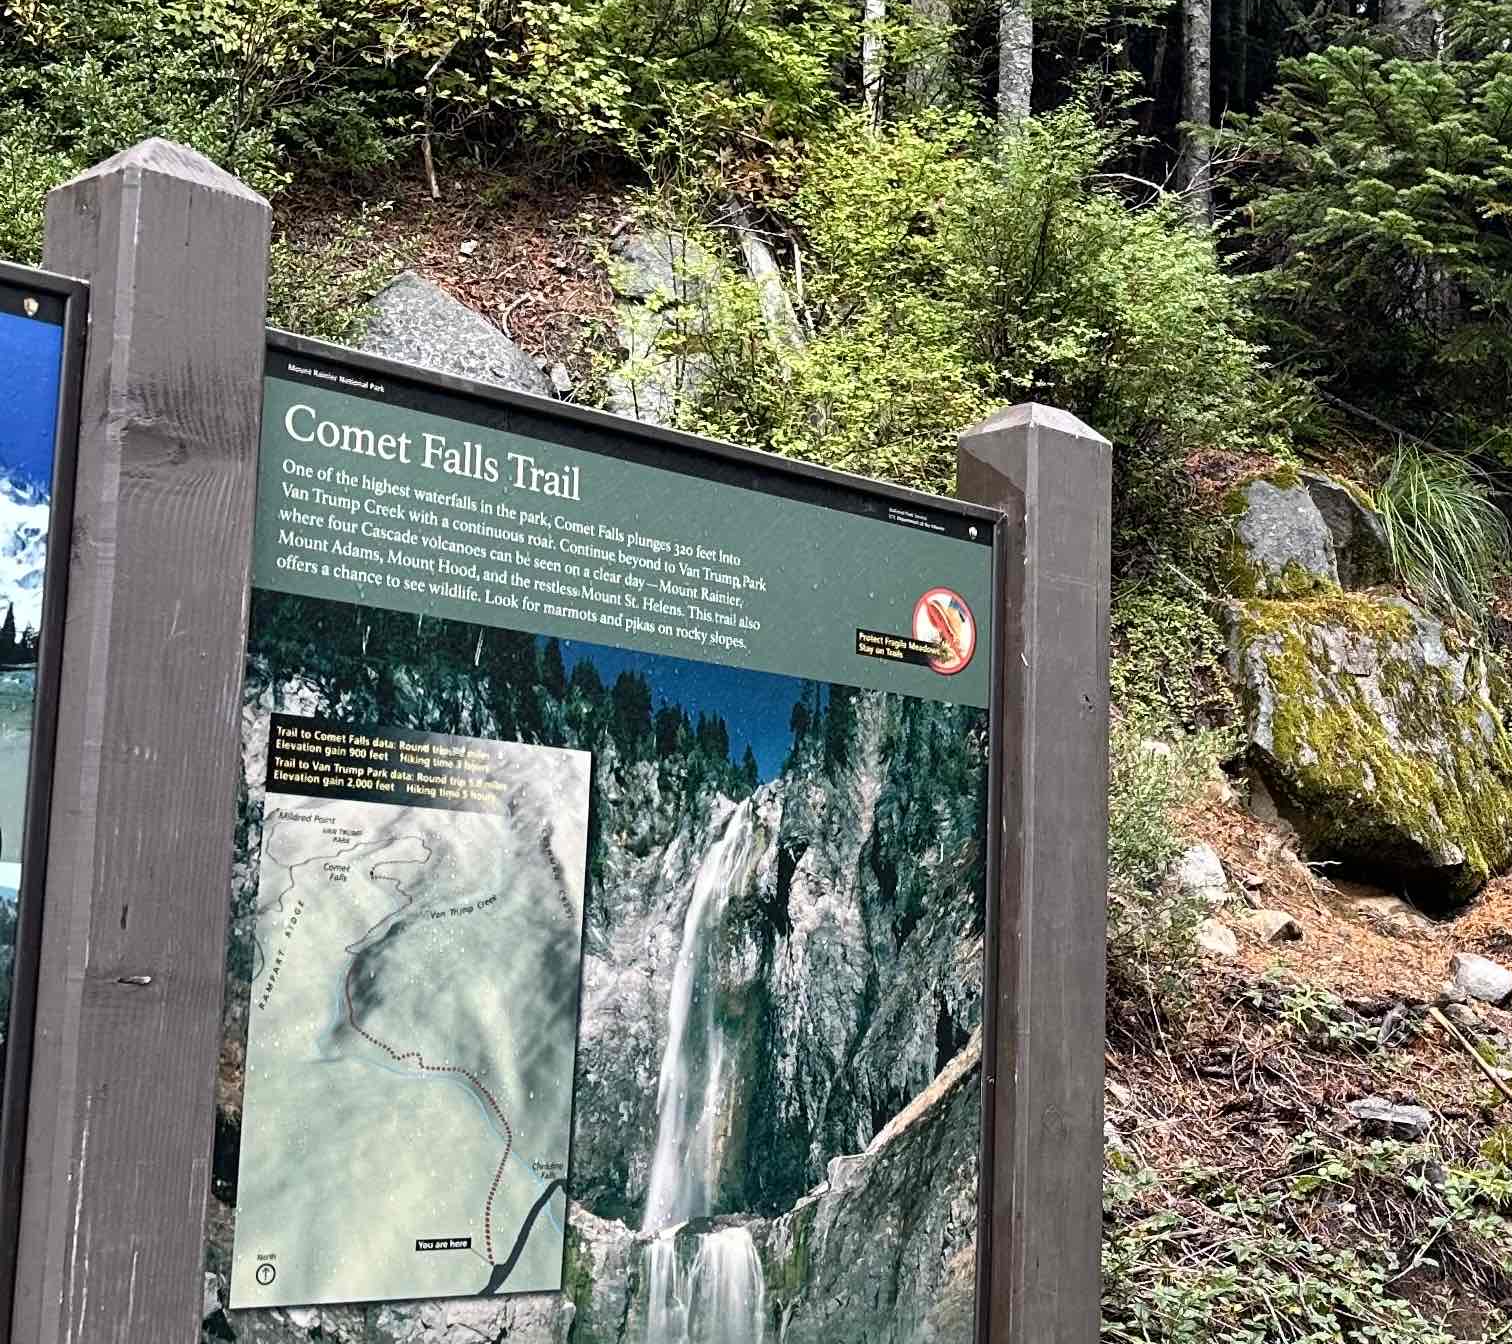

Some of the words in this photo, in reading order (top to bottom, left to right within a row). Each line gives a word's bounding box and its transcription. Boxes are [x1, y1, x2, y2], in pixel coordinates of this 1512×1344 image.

[370, 382, 384, 392] Park
[284, 405, 412, 464] Comet
[421, 433, 499, 482] Falls
[507, 452, 581, 501] Trail
[282, 460, 313, 478] One
[316, 469, 331, 481] of
[335, 471, 358, 486] the
[361, 476, 410, 498] highest
[413, 488, 477, 511] waterfalls
[480, 500, 492, 514] in
[496, 504, 516, 519] the
[519, 511, 551, 528] park,
[554, 516, 595, 536] Comet
[598, 524, 624, 542] Falls
[626, 532, 671, 552] plunges
[673, 543, 693, 556] 320
[695, 545, 716, 561] feet
[718, 549, 740, 565] into
[282, 483, 308, 501] Van
[315, 490, 360, 514] Trump
[363, 500, 404, 519] Creek
[408, 510, 437, 525] with
[441, 517, 449, 528] a
[452, 519, 524, 543] continuous
[527, 534, 555, 549] roar.
[559, 539, 615, 562] Continue
[618, 550, 661, 570] beyond
[664, 561, 675, 573] to
[678, 562, 699, 578] Van
[702, 567, 741, 588] Trump
[742, 575, 766, 591] Park
[277, 531, 328, 552] Mount
[330, 541, 383, 564] Adams,
[386, 551, 434, 574] Mount
[438, 560, 480, 581] Hood,
[482, 570, 507, 584] and
[510, 574, 530, 588] the
[533, 579, 580, 597] restless
[581, 586, 621, 605] Mount
[624, 594, 639, 608] St.
[642, 597, 685, 616] Helens.
[686, 605, 713, 622] This
[714, 612, 736, 626] trail
[738, 616, 760, 630] also
[278, 508, 323, 527] where
[327, 516, 358, 533] four
[361, 522, 418, 544] Cascade
[421, 535, 486, 558] volcanoes
[489, 549, 512, 563] can
[515, 552, 530, 566] be
[533, 557, 561, 572] seen
[564, 564, 580, 576] on
[583, 567, 590, 578] a
[592, 568, 622, 583] clear
[701, 587, 743, 608] Rainier,
[276, 556, 318, 574] offers
[321, 564, 329, 575] a
[333, 565, 382, 585] chance
[386, 574, 400, 587] to
[403, 579, 425, 592] see
[428, 583, 480, 602] wildlife.
[484, 591, 518, 608] Look
[521, 597, 540, 612] for
[543, 603, 597, 622] marmots
[599, 613, 623, 626] and
[624, 617, 655, 633] pikas
[657, 624, 673, 635] on
[675, 627, 707, 644] rocky
[709, 631, 746, 648] slopes.
[275, 739, 322, 753] Elevation
[325, 744, 346, 757] gain
[349, 747, 367, 759] 900
[369, 749, 389, 761] feet
[400, 752, 430, 767] Hiking
[276, 726, 298, 738] Trail
[301, 730, 312, 739] to
[314, 730, 346, 744] Comet
[349, 734, 370, 747] Falls
[372, 737, 396, 749] data:
[399, 740, 430, 753] Round
[273, 770, 320, 784] Elevation
[323, 775, 345, 787] gain
[375, 780, 395, 792] feet
[406, 783, 436, 797] Hiking
[439, 786, 460, 799] time
[274, 756, 296, 768] Trail
[299, 759, 310, 769] to
[312, 759, 331, 772] Van
[334, 762, 364, 777] Trump
[367, 766, 387, 778] Park
[390, 768, 413, 782] data:
[417, 772, 447, 785] Round
[418, 1241, 433, 1249] You
